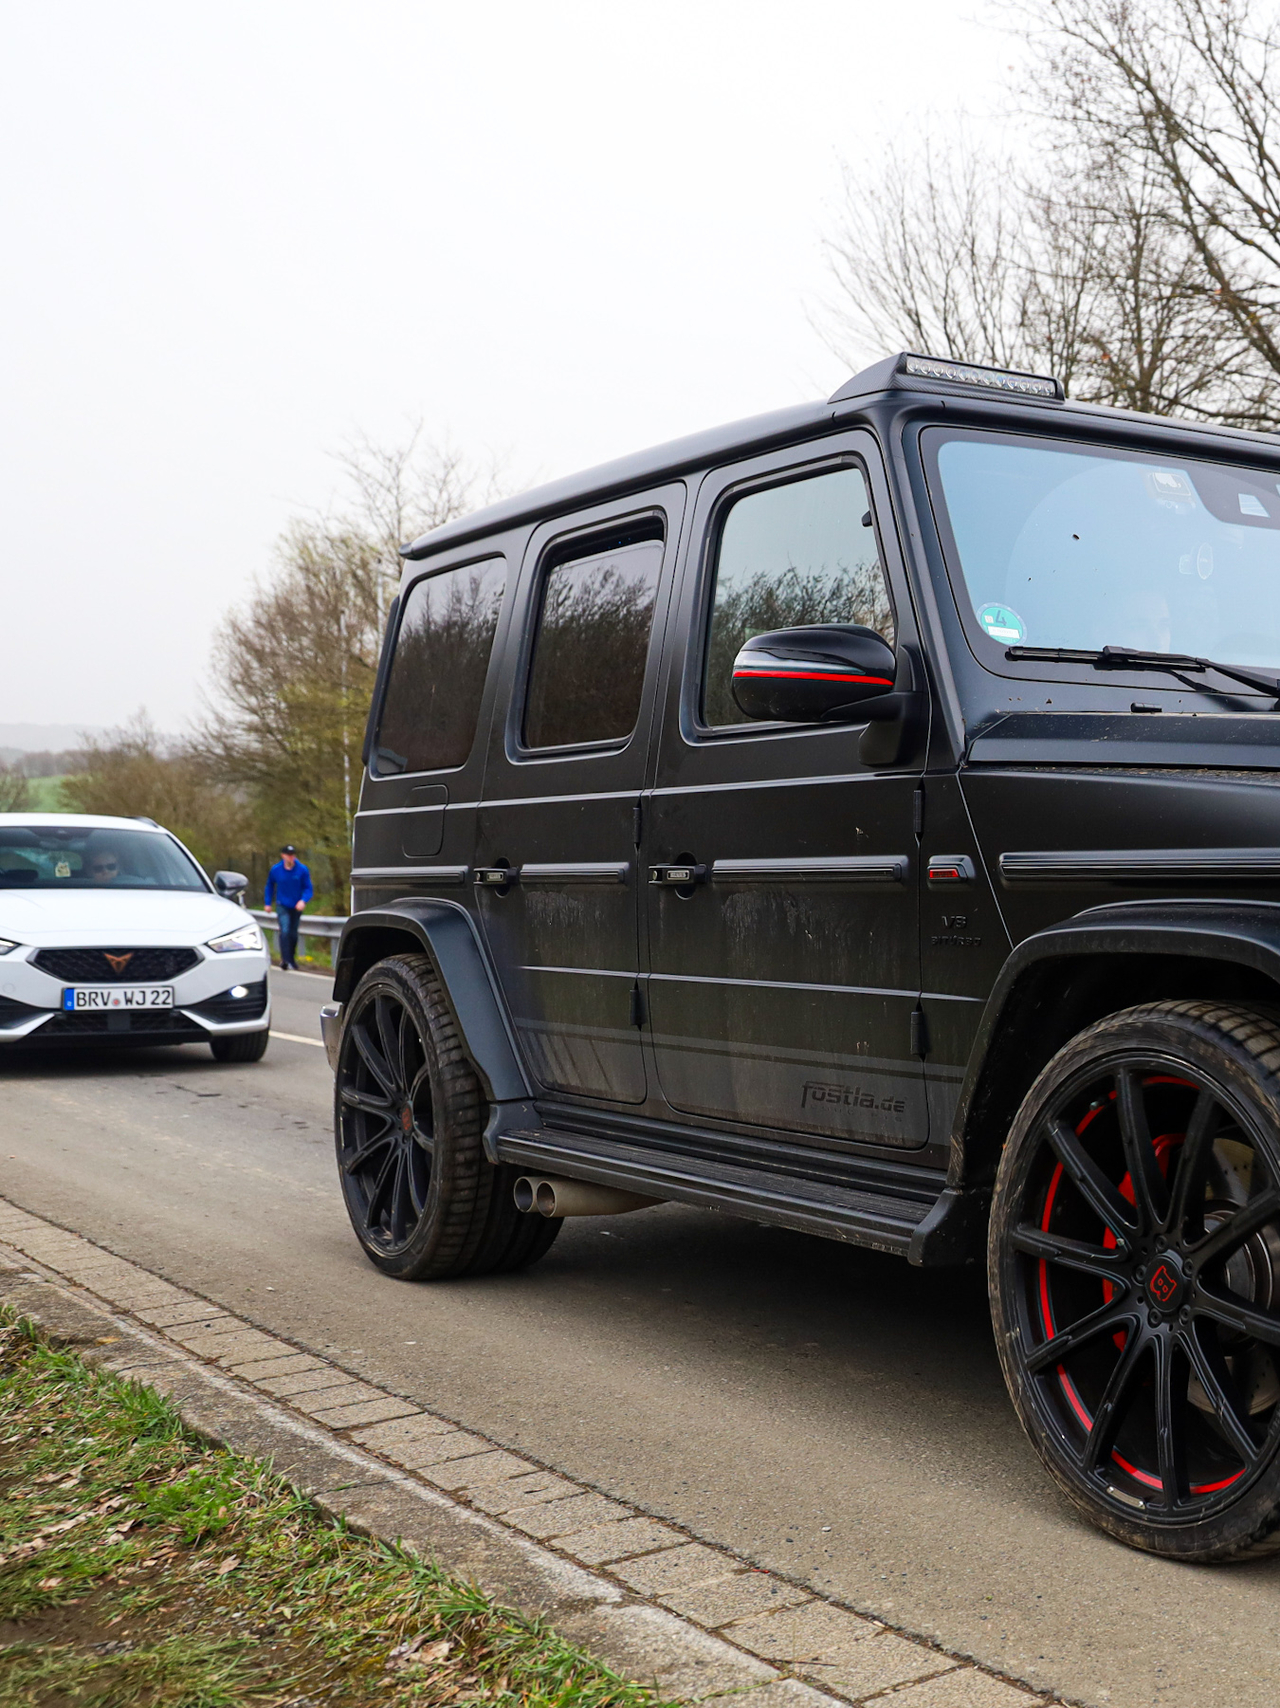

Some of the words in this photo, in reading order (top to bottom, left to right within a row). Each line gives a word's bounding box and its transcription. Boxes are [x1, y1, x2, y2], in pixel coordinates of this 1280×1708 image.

[995, 610, 1007, 626] 4
[941, 915, 967, 928] V8
[931, 935, 981, 946] BITURBO
[76, 991, 111, 1007] BRV
[123, 990, 146, 1005] WJ
[150, 989, 171, 1005] 22
[1150, 1265, 1177, 1302] B
